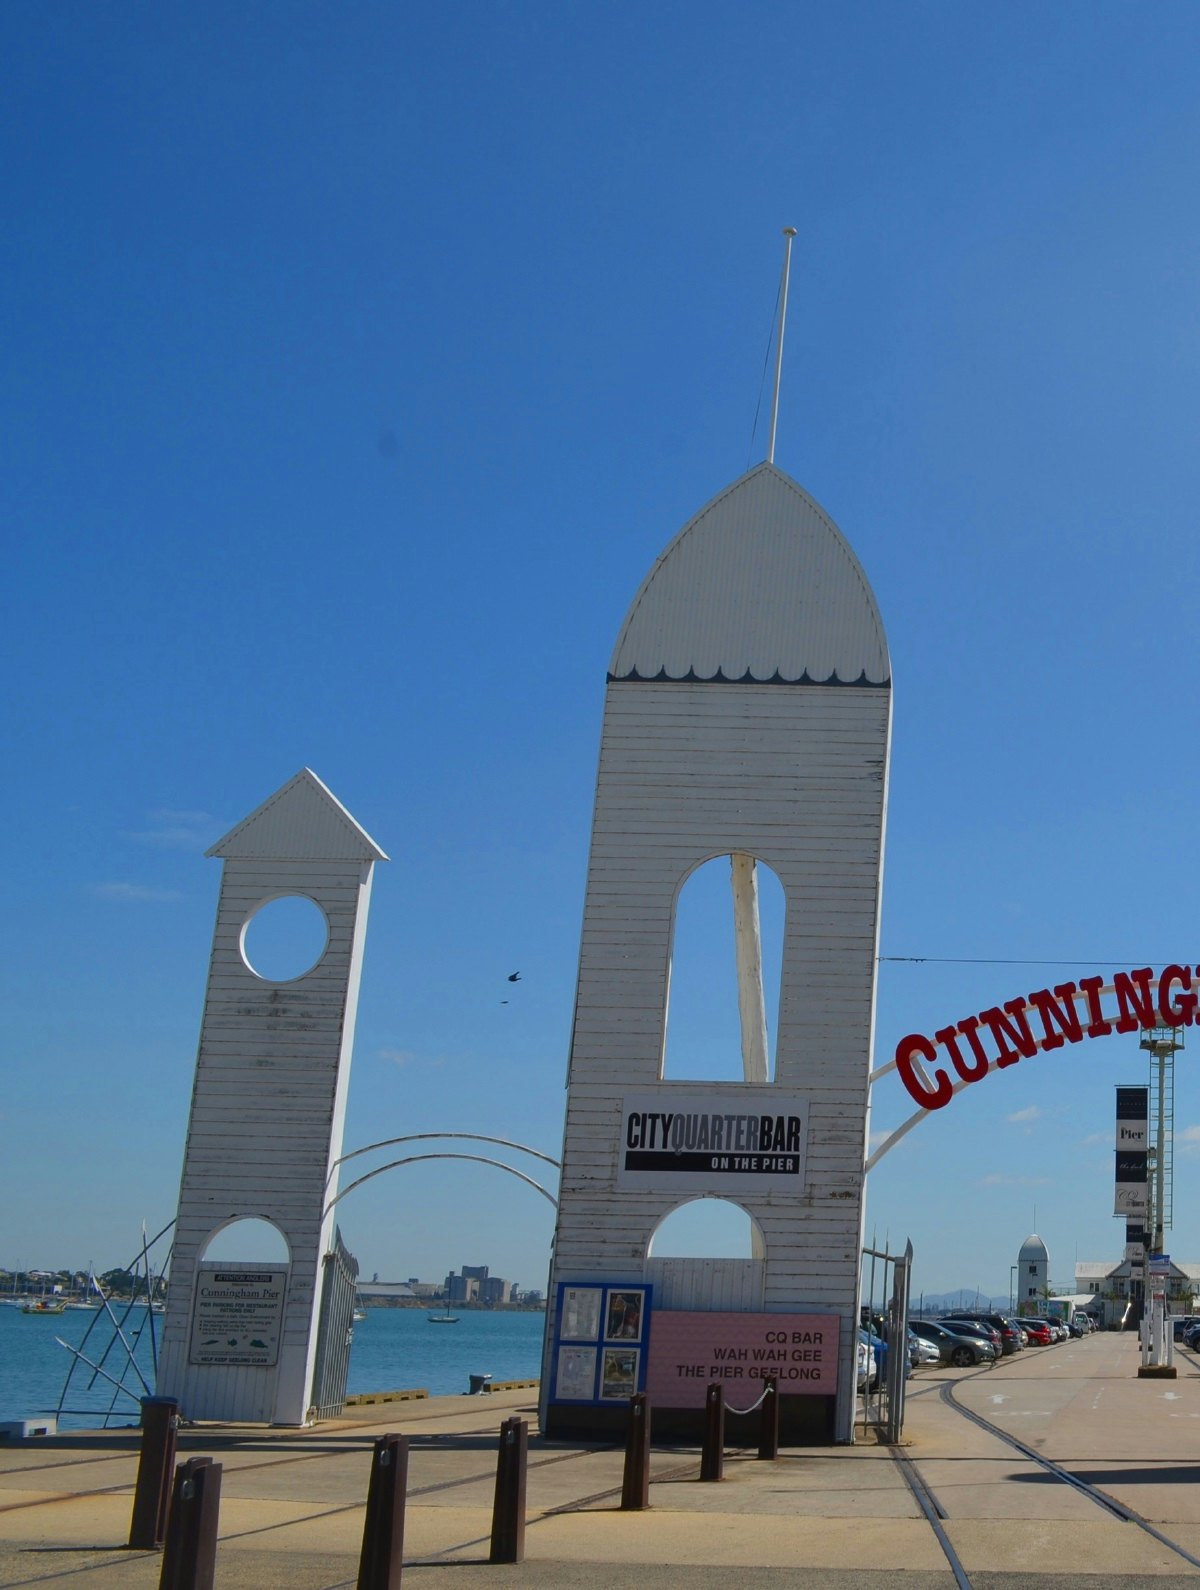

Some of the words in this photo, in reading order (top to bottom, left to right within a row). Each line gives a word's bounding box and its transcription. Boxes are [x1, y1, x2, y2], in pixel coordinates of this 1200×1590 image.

[1121, 1126, 1144, 1139] Pier
[711, 1157, 729, 1169] ON
[734, 1158, 757, 1170] THE
[762, 1159, 794, 1171] PIER
[201, 1287, 259, 1299] Cunningham
[263, 1288, 280, 1298] Pier
[765, 1331, 787, 1344] CQ
[792, 1332, 823, 1344] BAR
[713, 1348, 748, 1360] WAH
[752, 1349, 787, 1361] WAH
[791, 1349, 822, 1361] GEE
[676, 1365, 705, 1377] THE
[710, 1366, 743, 1378] PIER
[748, 1367, 821, 1380] GEELONG
